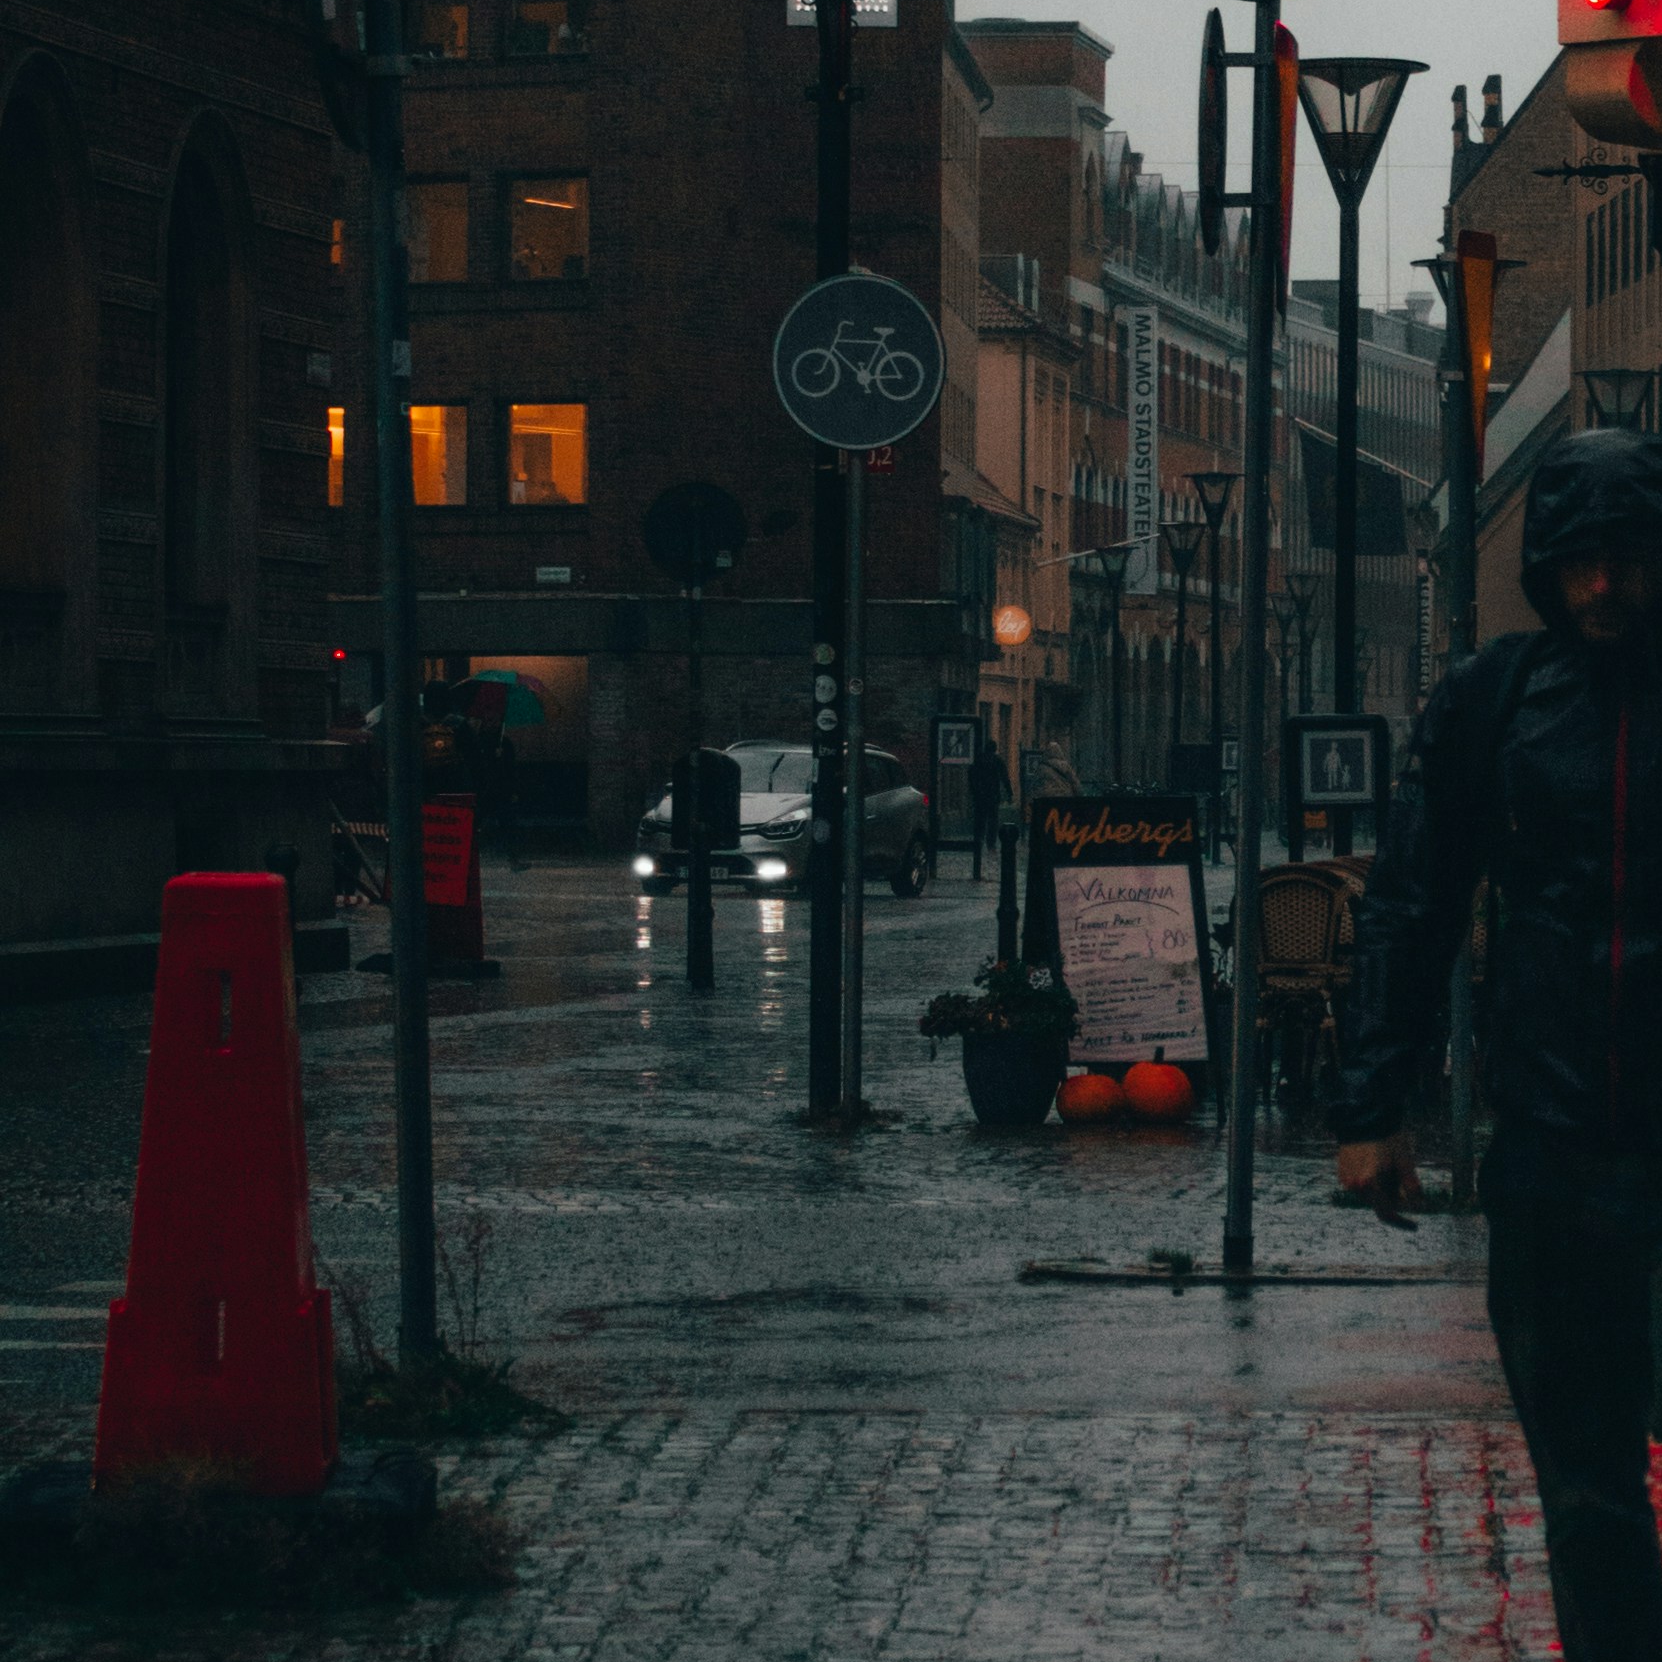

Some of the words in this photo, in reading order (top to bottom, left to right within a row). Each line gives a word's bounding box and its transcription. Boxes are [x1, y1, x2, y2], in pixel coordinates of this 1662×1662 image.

[1135, 314, 1154, 396] MALMÖ
[1134, 404, 1152, 544] STADSTEATER
[1044, 805, 1194, 859] Nybergs
[1075, 878, 1175, 901] VÄLKOMNA
